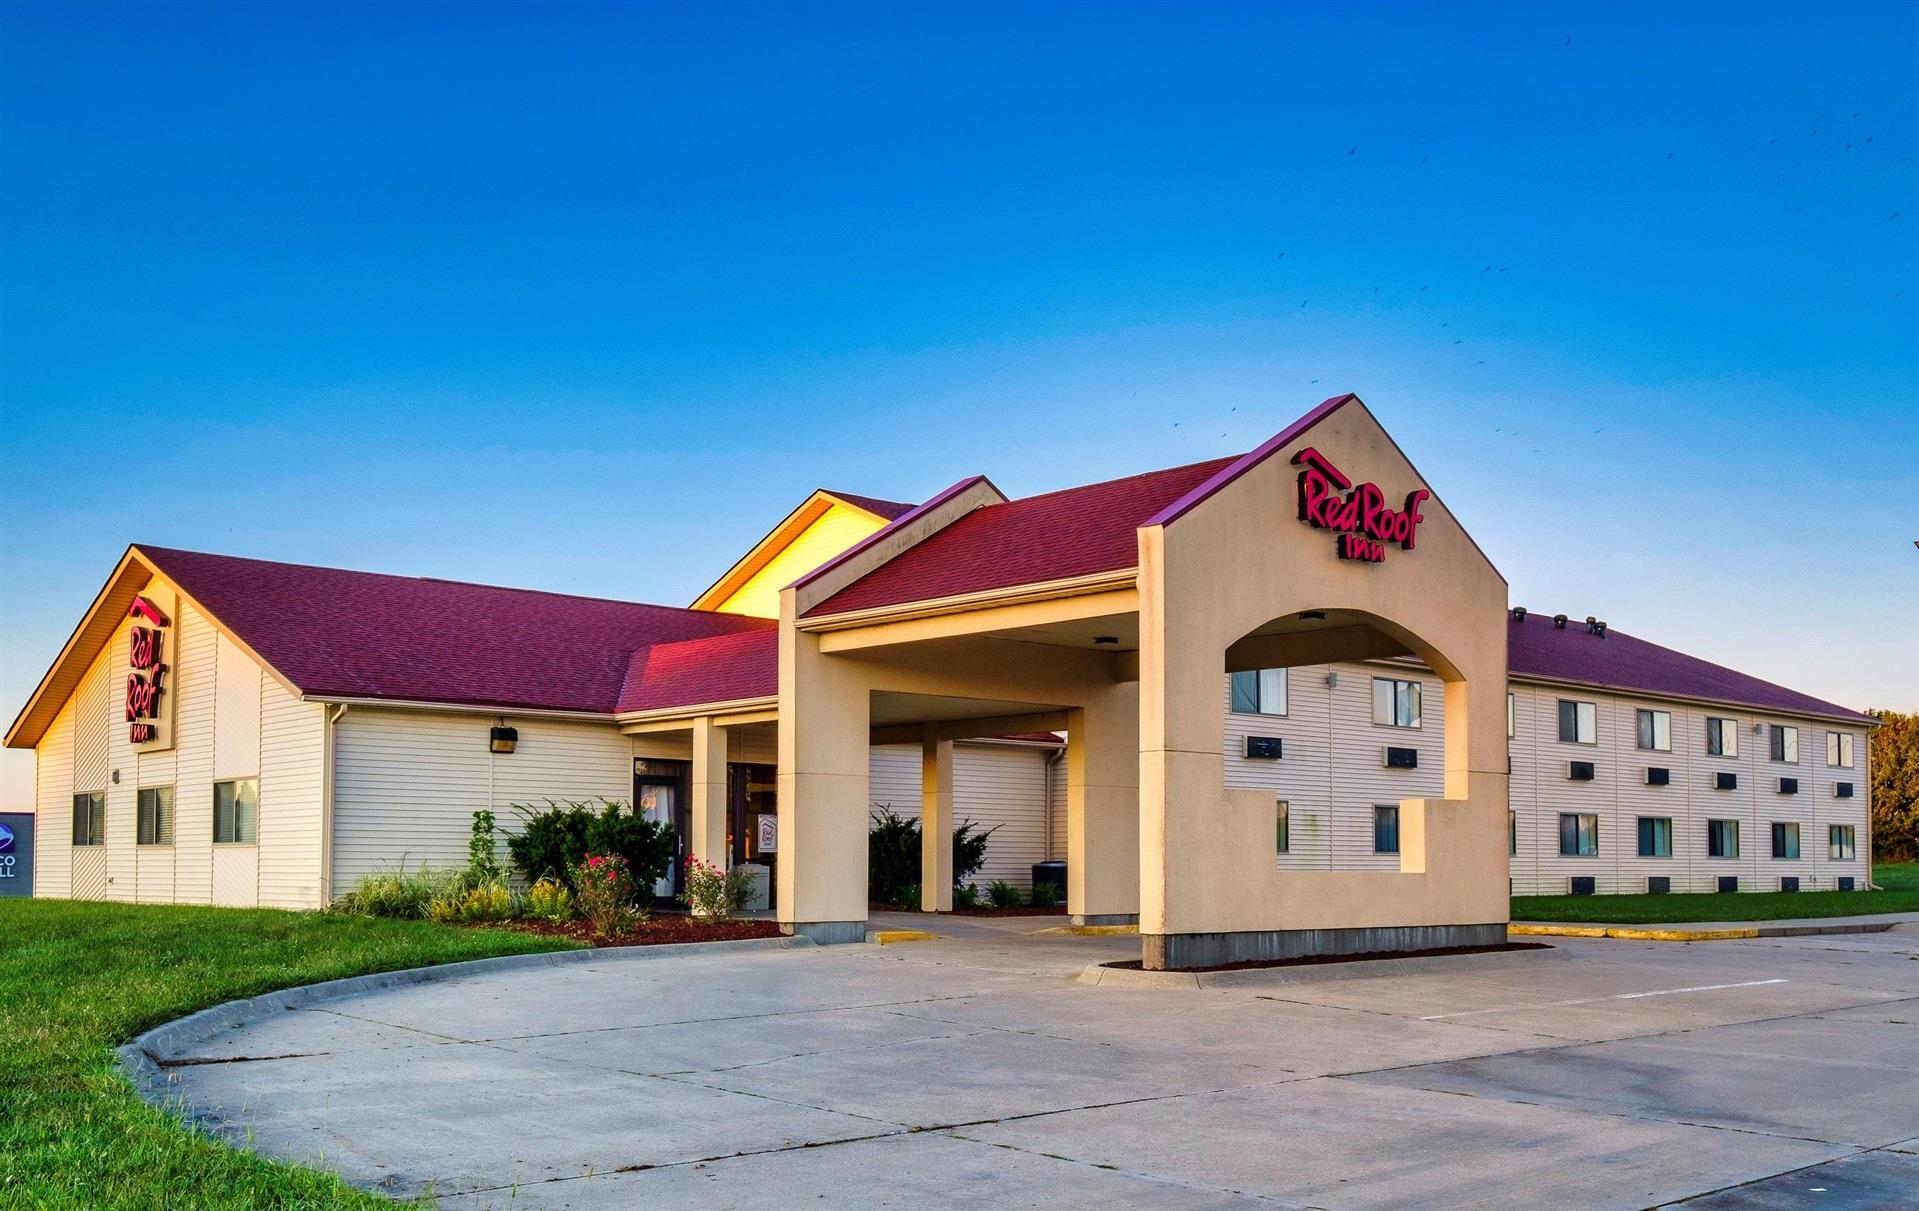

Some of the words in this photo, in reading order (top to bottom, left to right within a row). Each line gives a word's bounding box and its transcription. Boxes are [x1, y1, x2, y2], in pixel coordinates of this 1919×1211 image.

[1302, 468, 1362, 533] Red
[1362, 482, 1429, 550] Roof
[130, 625, 156, 669] Red
[126, 662, 161, 722] Roof
